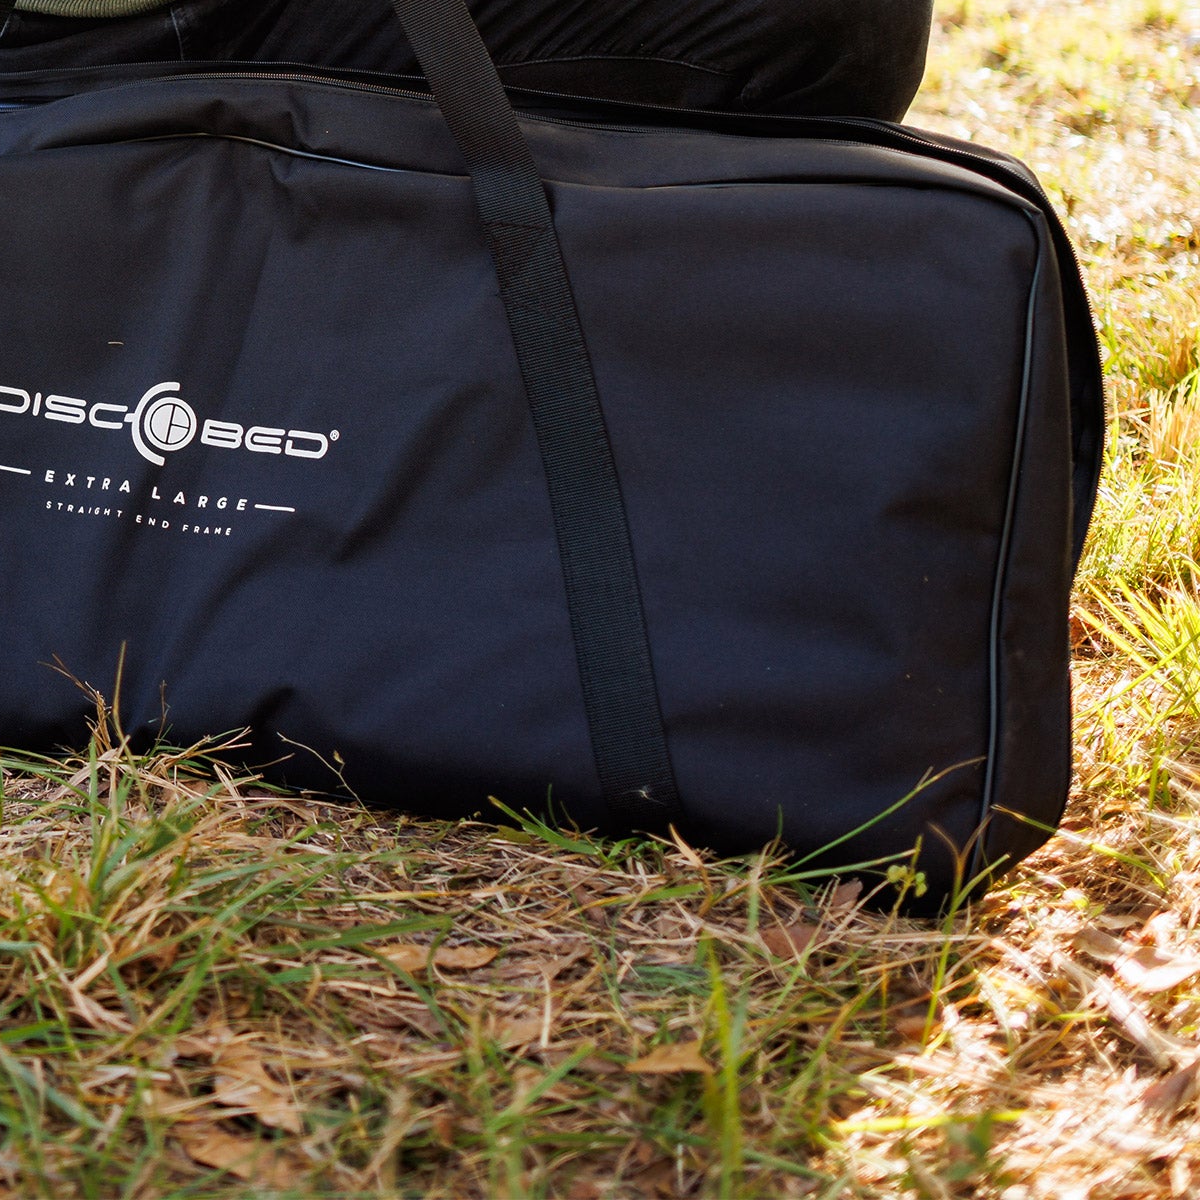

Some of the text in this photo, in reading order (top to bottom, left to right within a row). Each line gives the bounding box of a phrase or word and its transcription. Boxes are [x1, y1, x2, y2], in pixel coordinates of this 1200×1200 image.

[44, 470, 249, 511] EXTRA LARGE
[45, 500, 232, 536] STRAIGHT END FRAME
